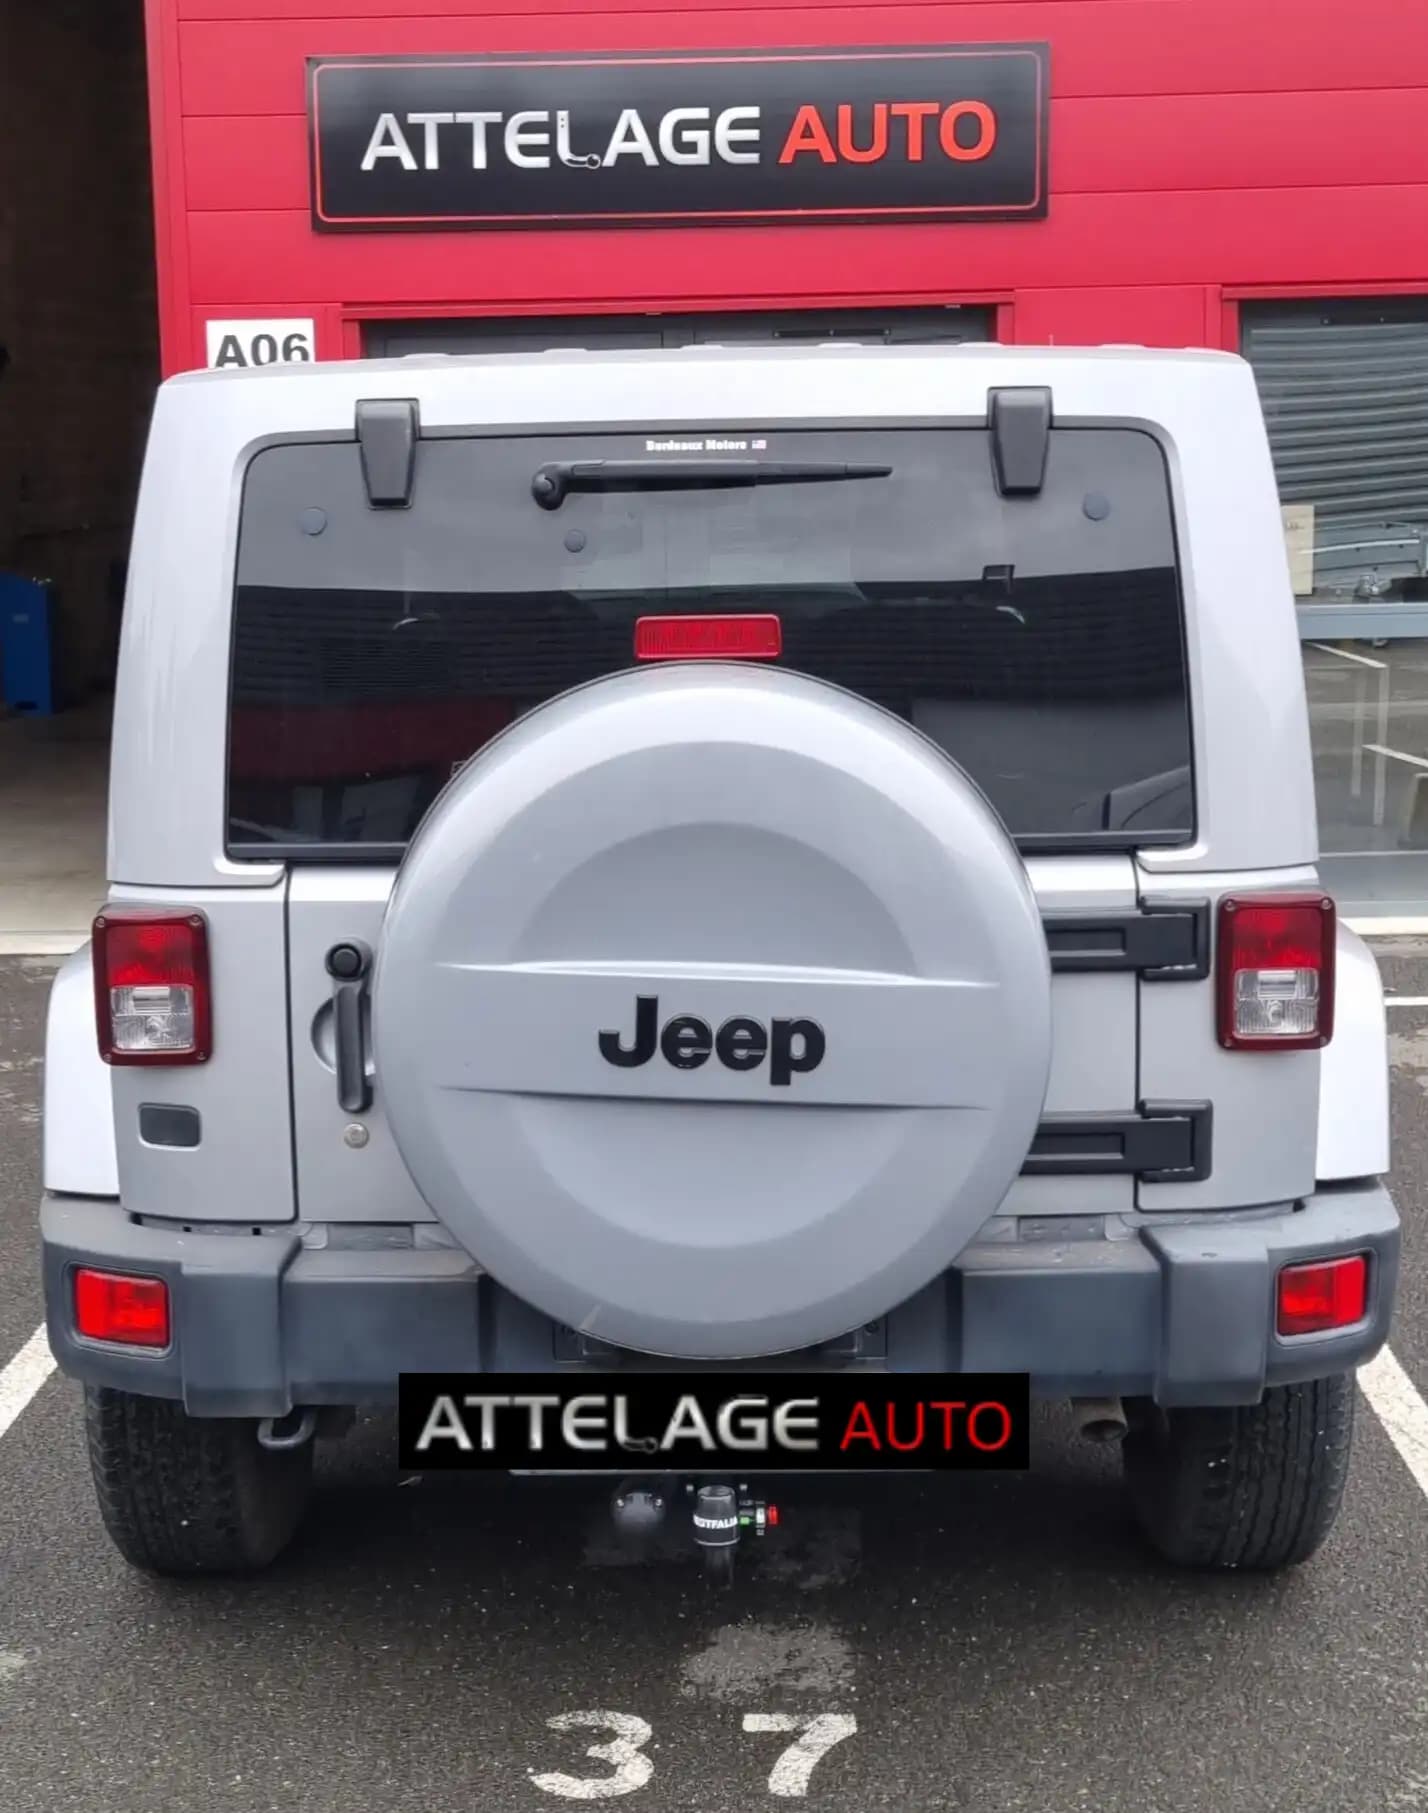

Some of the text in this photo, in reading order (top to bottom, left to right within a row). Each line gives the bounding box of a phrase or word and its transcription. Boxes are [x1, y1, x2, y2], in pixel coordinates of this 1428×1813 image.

[359, 100, 997, 170] ATTELAGE AUTO
[215, 333, 310, 367] A06
[598, 994, 826, 1086] Jeep
